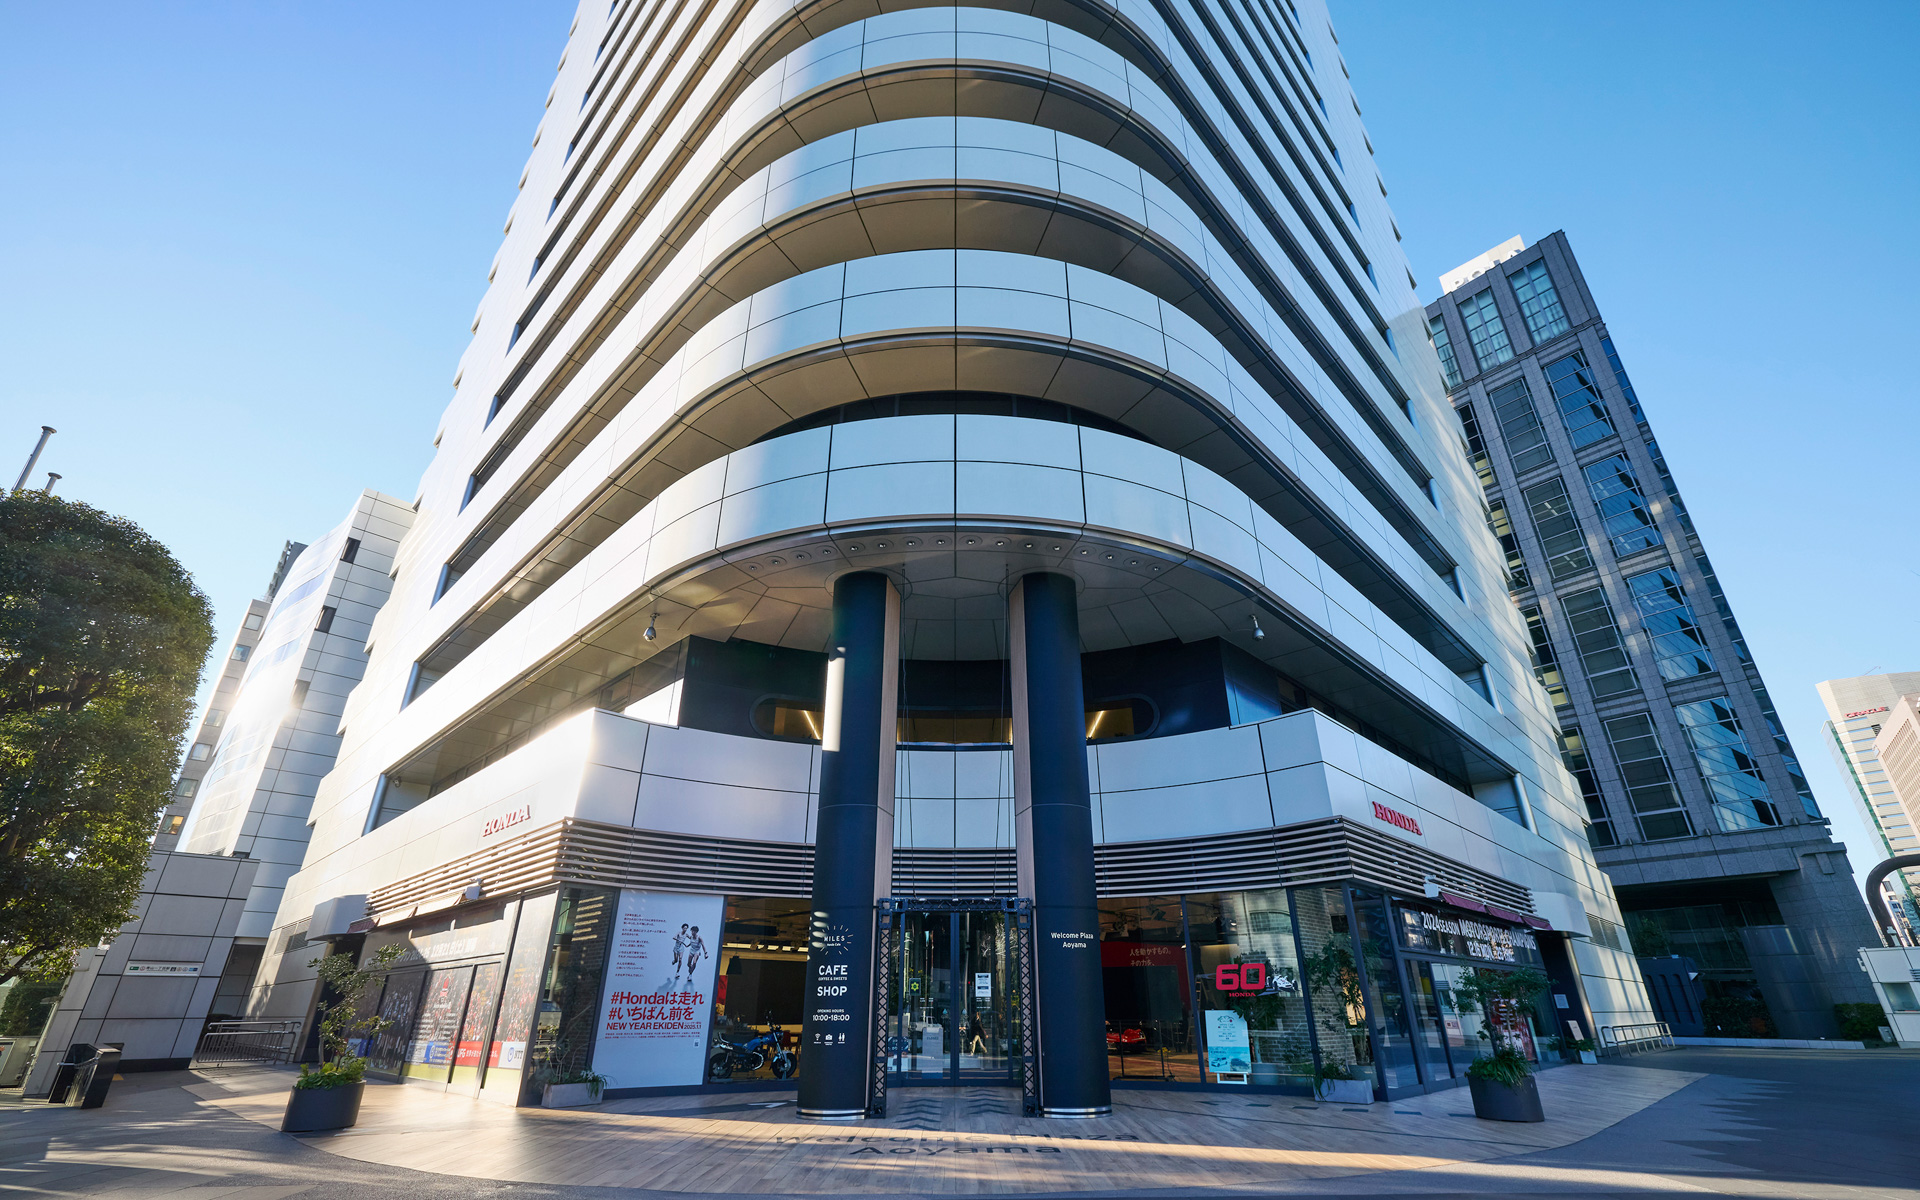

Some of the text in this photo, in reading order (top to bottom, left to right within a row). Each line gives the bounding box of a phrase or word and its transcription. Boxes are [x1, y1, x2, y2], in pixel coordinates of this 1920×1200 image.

[482, 804, 531, 838] HONDA
[1372, 801, 1422, 836] HONDA
[1062, 941, 1087, 949] Aoyama
[818, 964, 848, 975] CAFE
[1215, 963, 1266, 990] 60
[817, 985, 848, 997] SHOP
[610, 991, 704, 1006] #Hondaは走れ
[608, 1006, 695, 1021] #いちばん前を
[606, 1022, 627, 1030] NEW
[629, 1022, 652, 1030] YEAR
[652, 1022, 684, 1030] EKIDEN
[775, 1133, 1139, 1144] Welcome Plaza
[849, 1146, 1062, 1156] Aoyama
